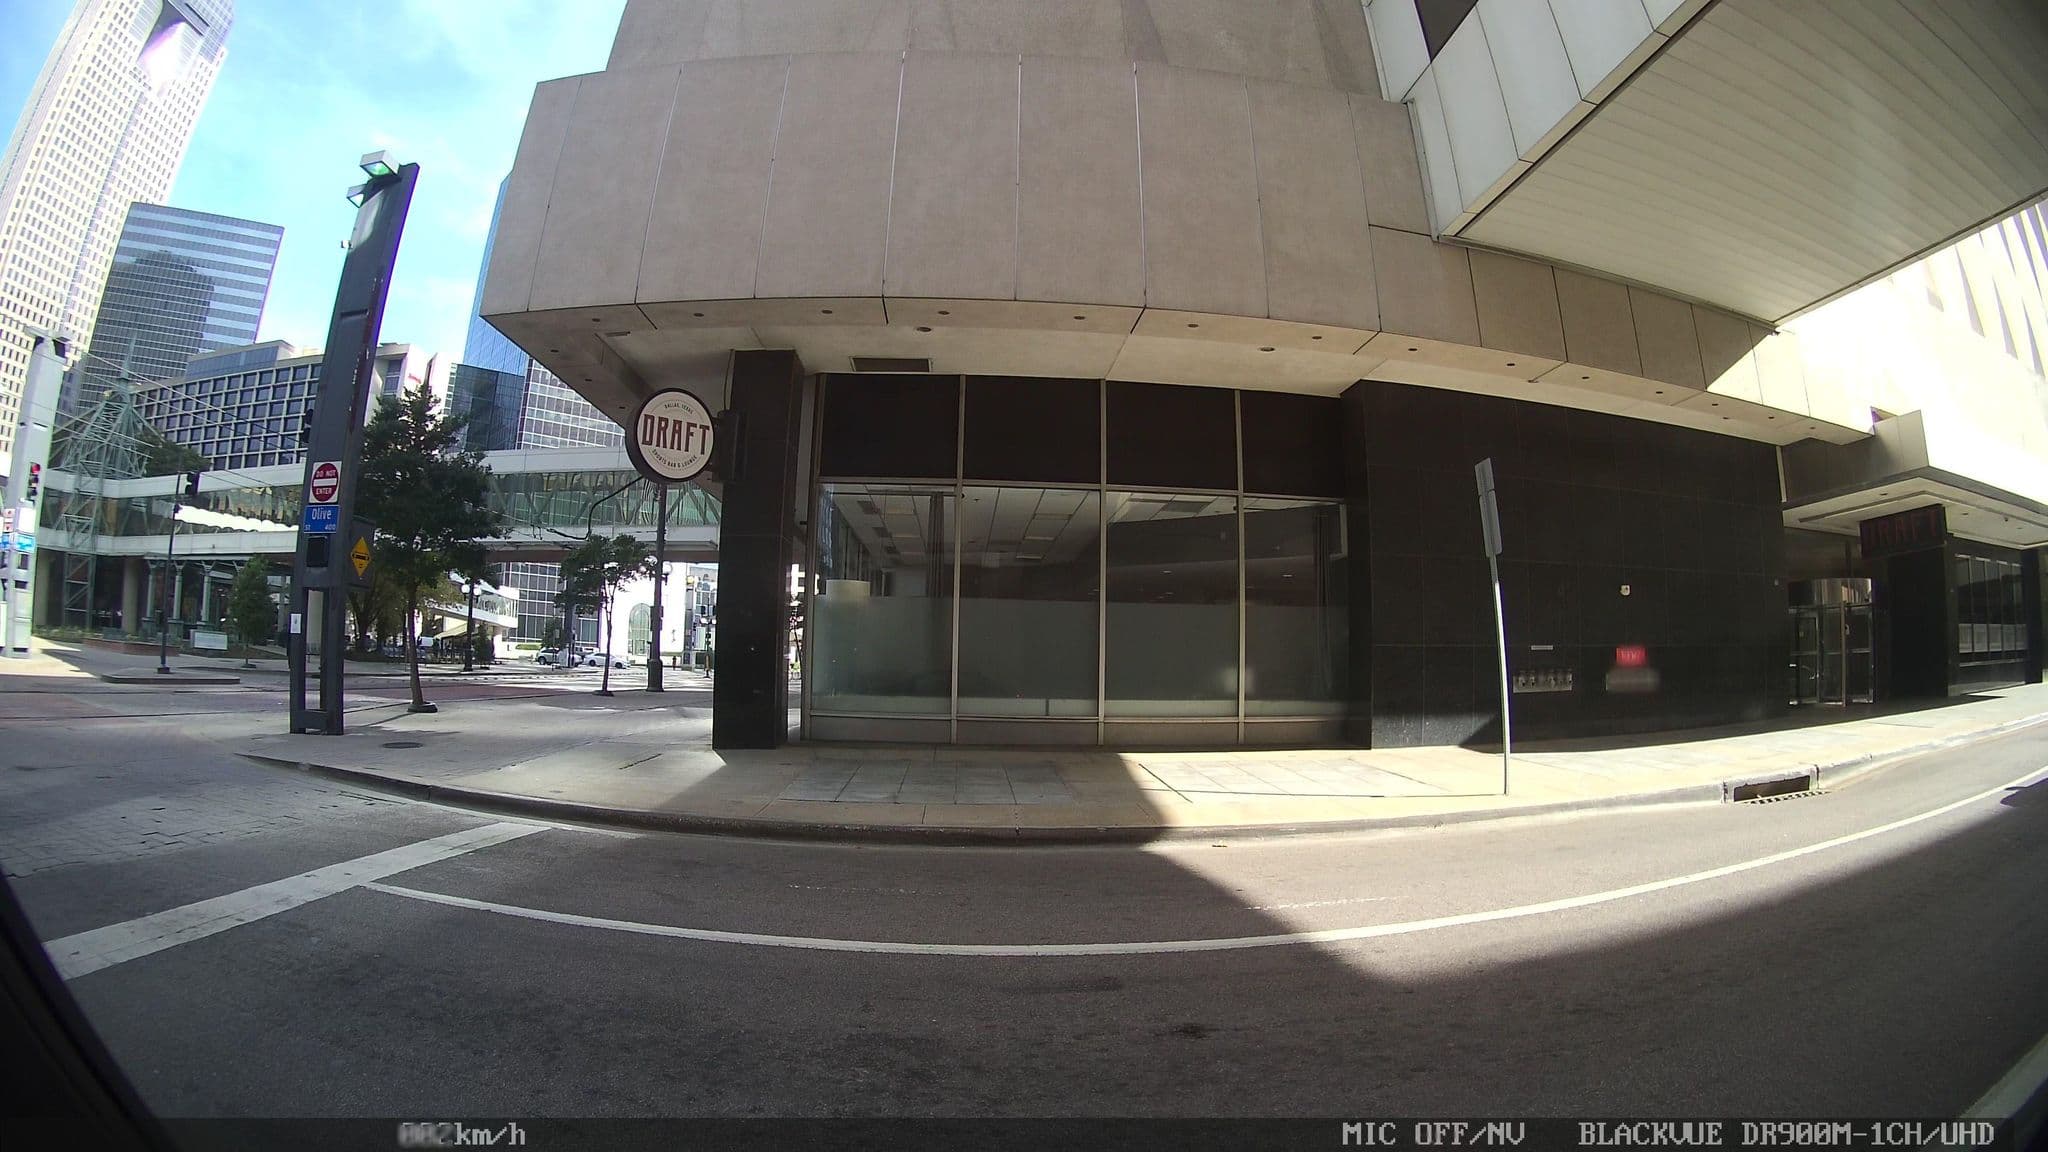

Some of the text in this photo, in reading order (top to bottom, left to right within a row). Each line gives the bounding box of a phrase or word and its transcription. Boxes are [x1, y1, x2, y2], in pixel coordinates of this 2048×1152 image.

[641, 413, 710, 455] DRAFT
[316, 470, 323, 478] DO
[315, 487, 332, 495] ENTER
[311, 508, 332, 520] Olive
